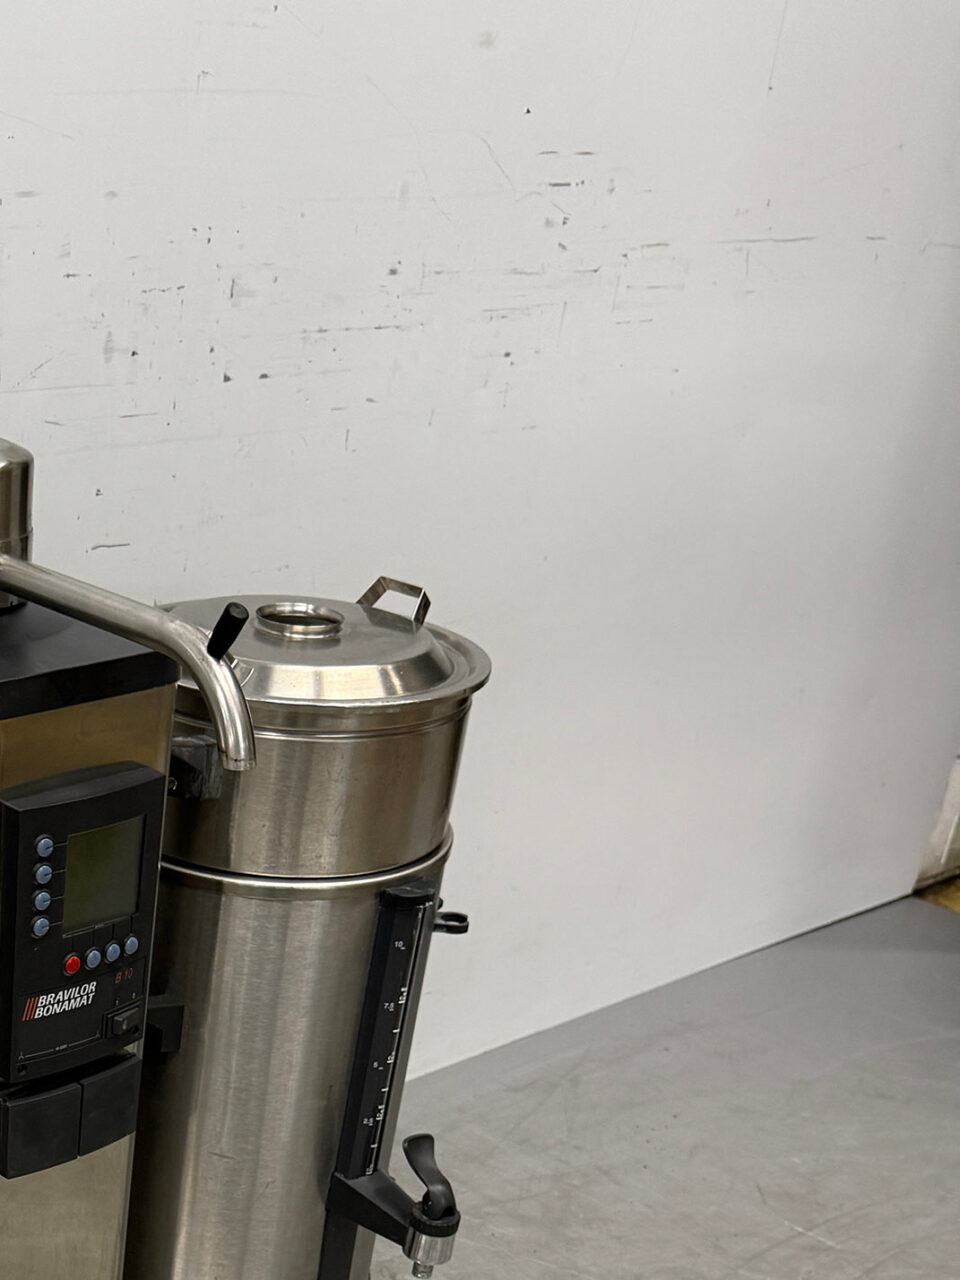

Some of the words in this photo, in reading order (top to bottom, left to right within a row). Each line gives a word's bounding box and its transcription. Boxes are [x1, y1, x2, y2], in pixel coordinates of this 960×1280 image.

[115, 972, 122, 984] B
[125, 967, 133, 979] 10
[34, 992, 96, 1019] BONAMAT
[38, 981, 97, 1007] BRAVILOR
